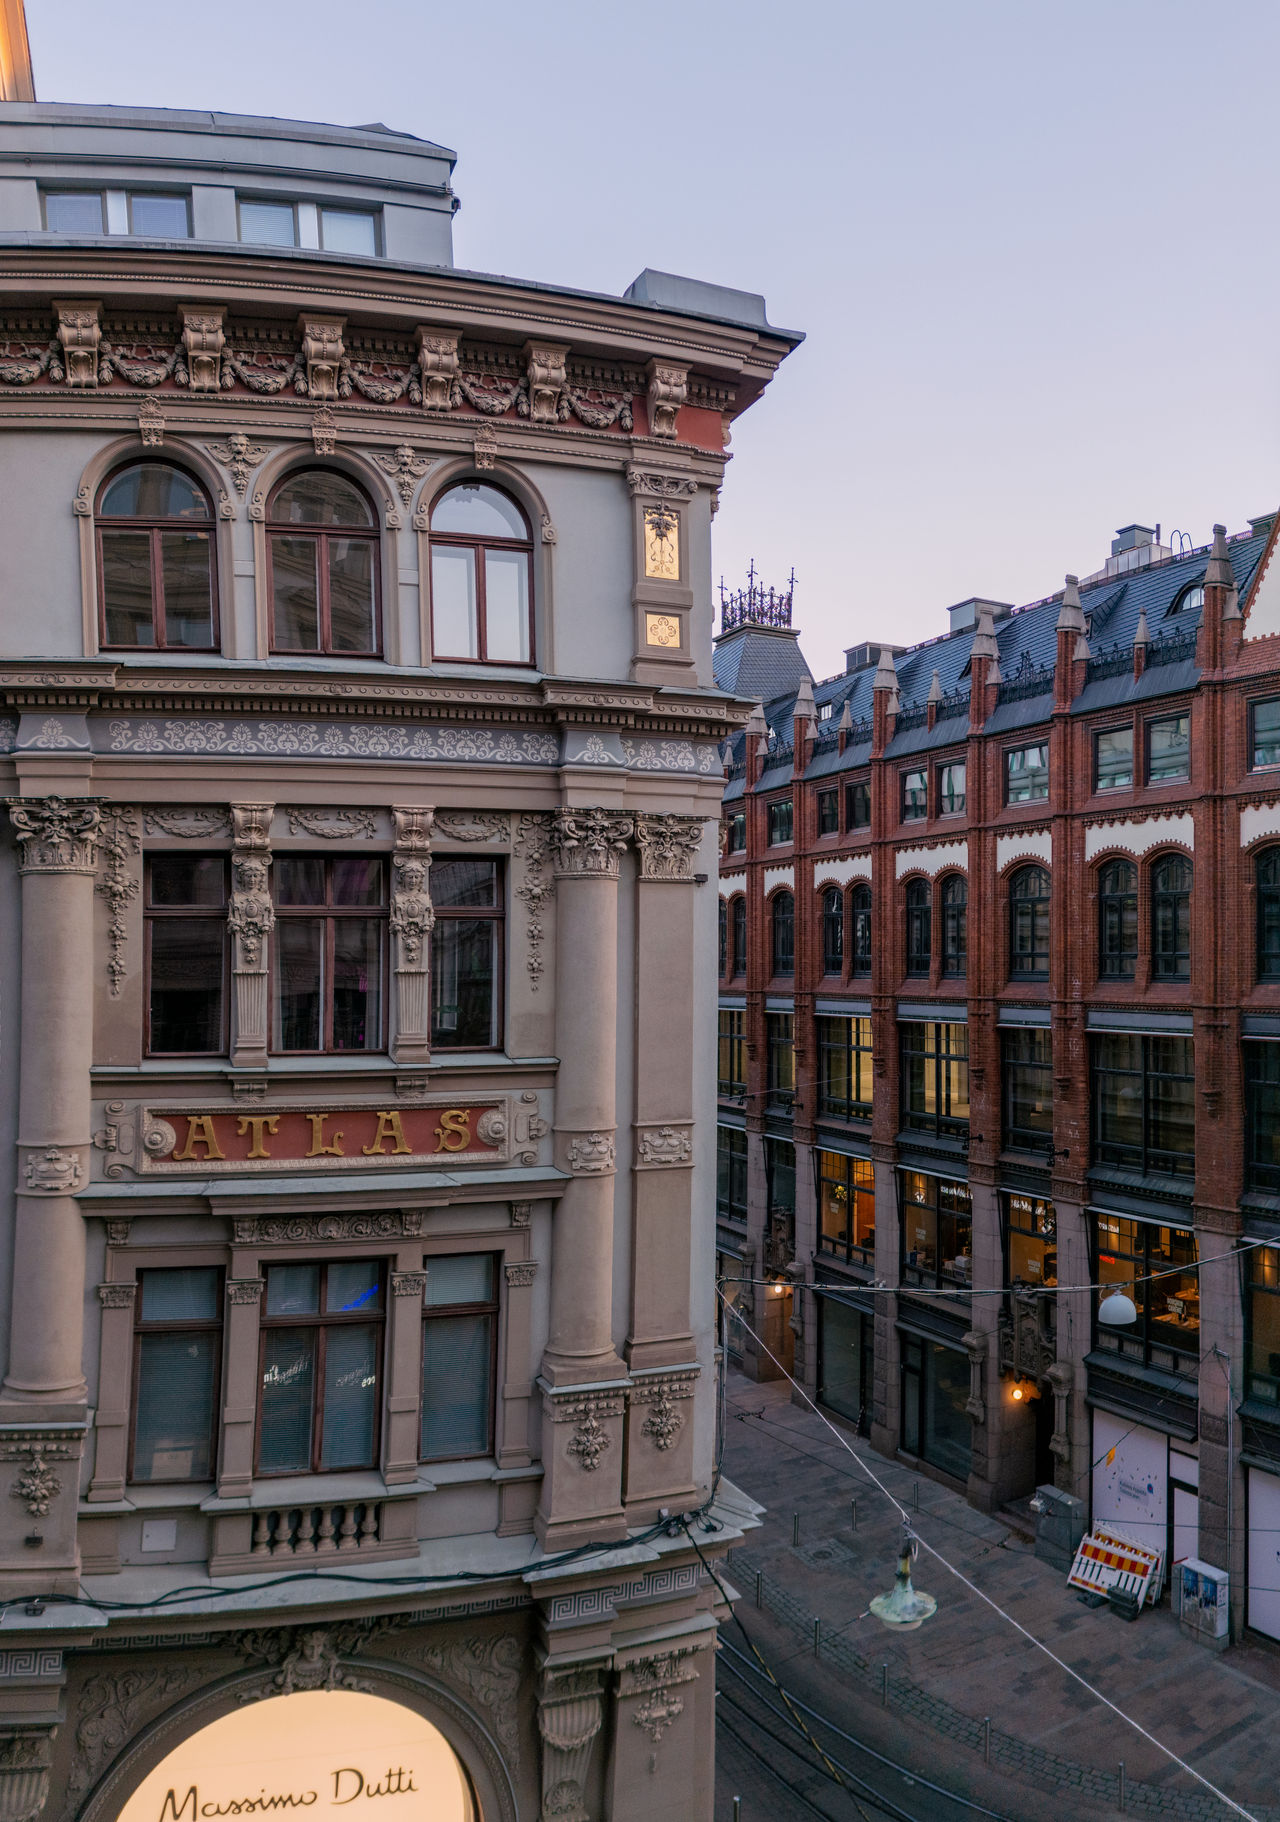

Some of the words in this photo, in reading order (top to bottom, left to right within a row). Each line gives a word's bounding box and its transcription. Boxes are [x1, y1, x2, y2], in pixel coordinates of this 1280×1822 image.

[172, 1109, 471, 1161] ATLAS
[159, 1784, 318, 1822] Massimo
[330, 1766, 418, 1805] Dutti
